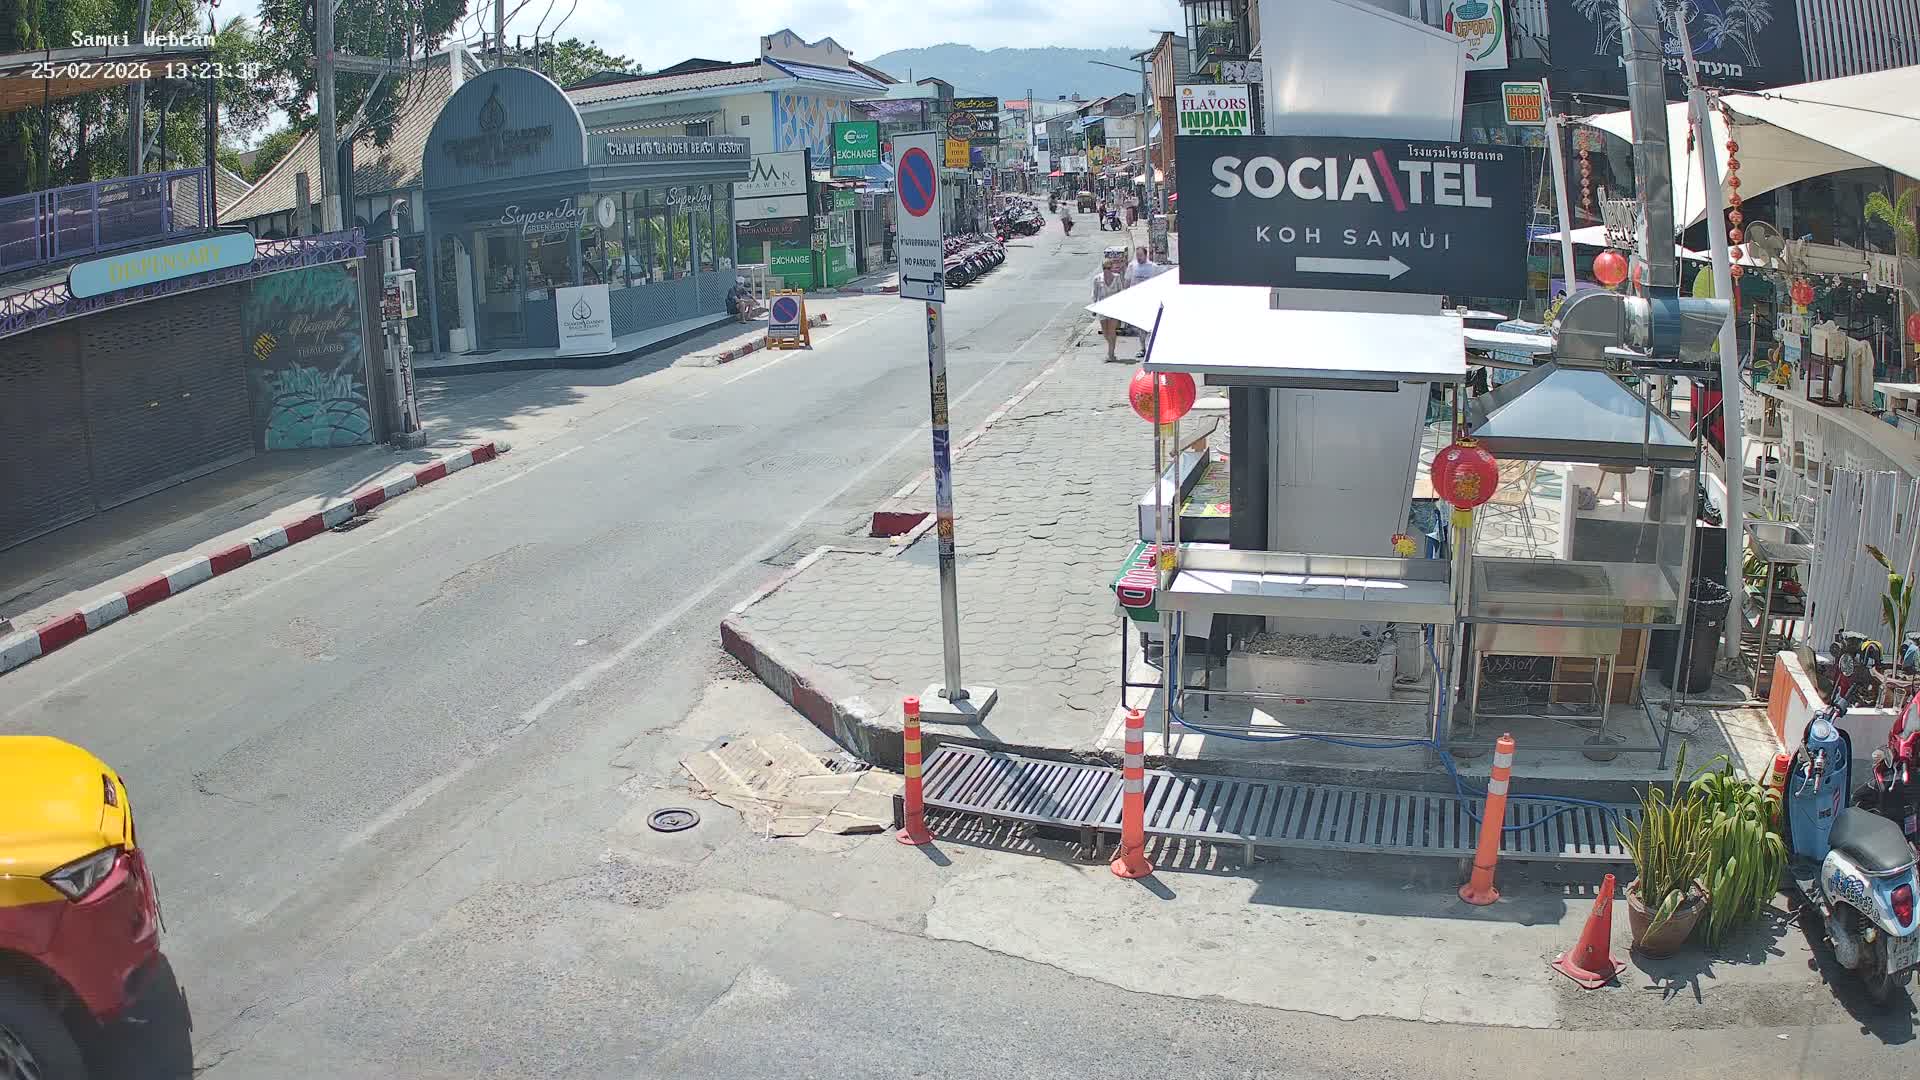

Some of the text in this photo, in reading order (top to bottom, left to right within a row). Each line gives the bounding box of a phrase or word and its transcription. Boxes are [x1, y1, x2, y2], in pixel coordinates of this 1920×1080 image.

[1182, 98, 1246, 110] FLAVORS
[1506, 94, 1541, 106] INDIAN
[1180, 111, 1247, 128] INDIAN
[1510, 107, 1540, 120] FOOD
[608, 142, 745, 156] CHAWENG GARDEN BEACH RESORT
[837, 149, 877, 160] EXCHANGE
[1256, 225, 1450, 250] KOH SAMUI
[108, 244, 223, 284] DISPENSARY
[771, 255, 810, 265] EXCHANGE
[904, 257, 937, 268] NO PARKING
[253, 331, 272, 355] PINE
[297, 344, 344, 357] THAILAND
